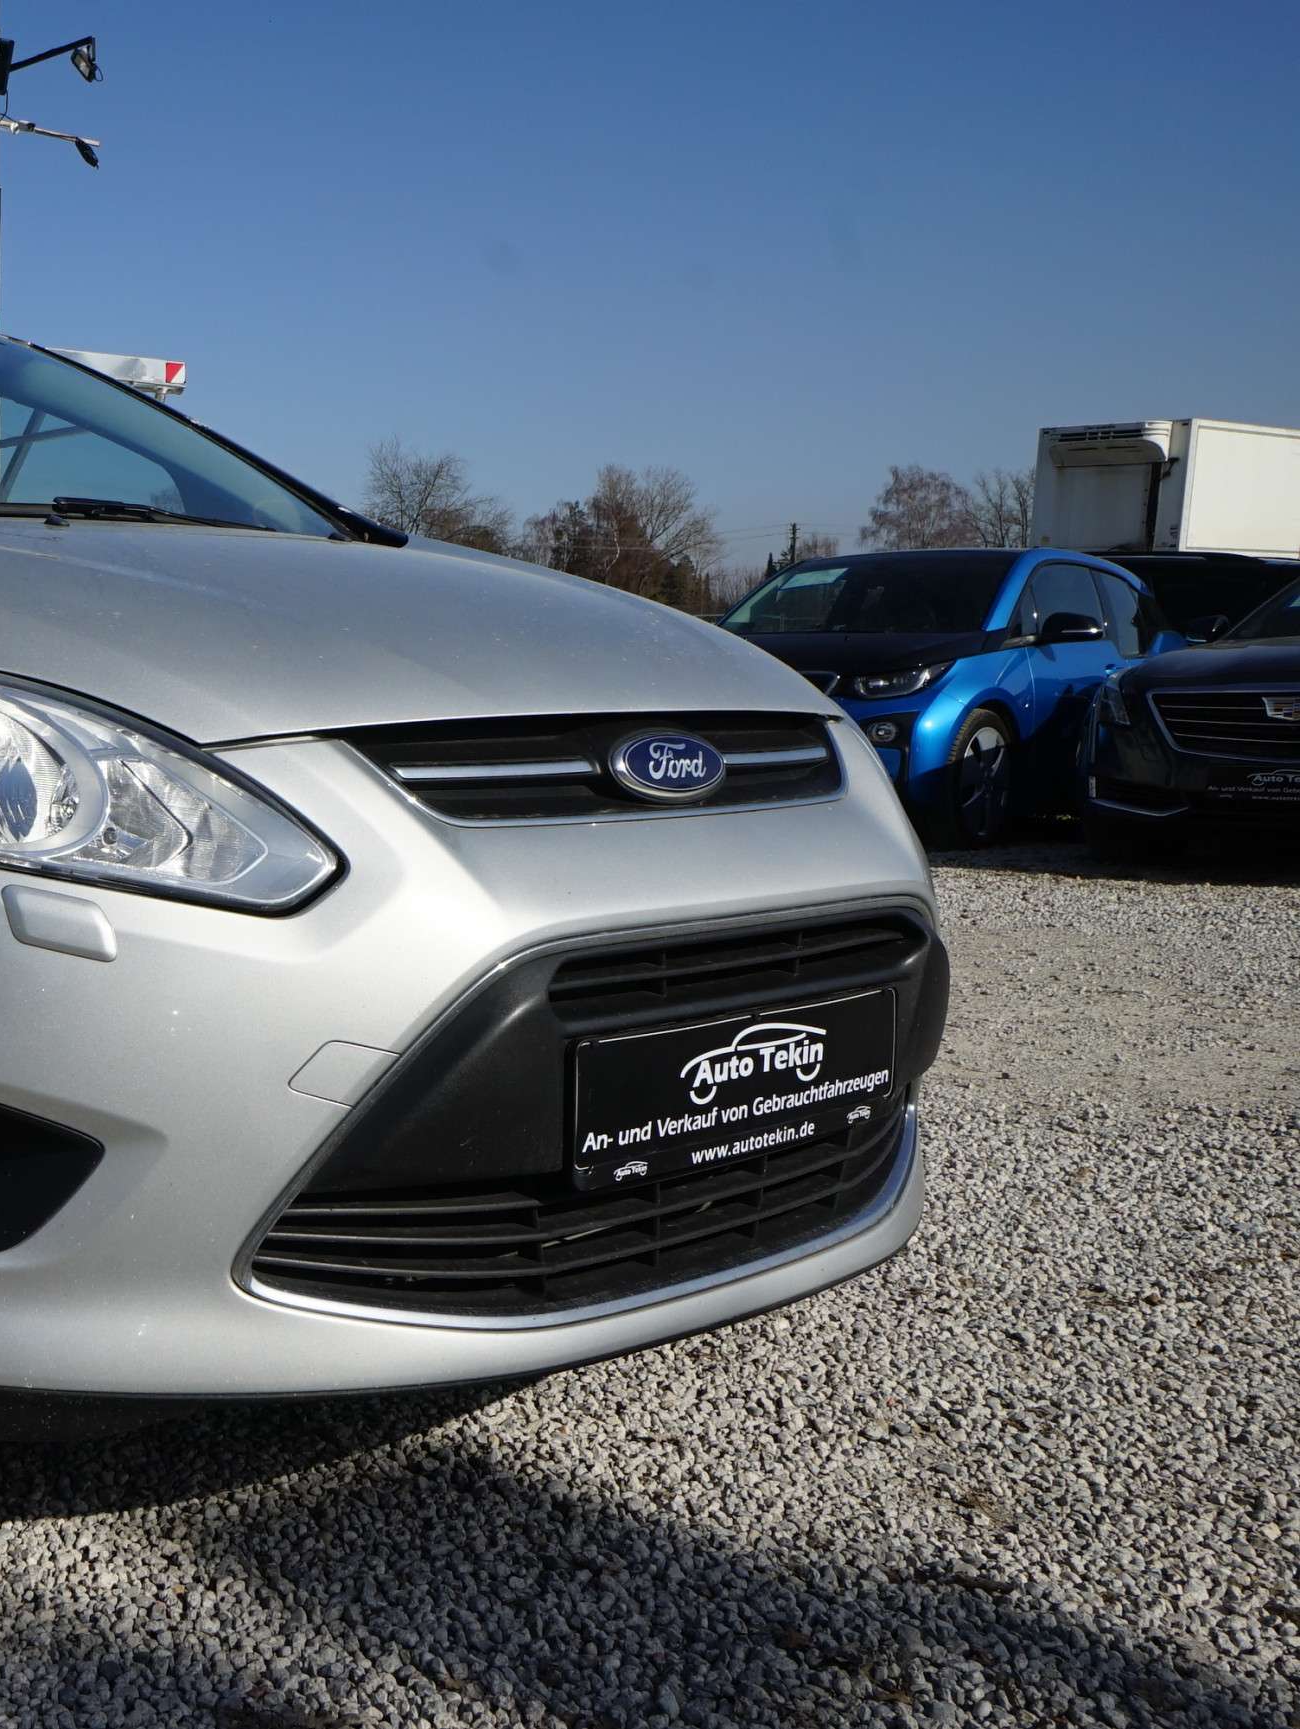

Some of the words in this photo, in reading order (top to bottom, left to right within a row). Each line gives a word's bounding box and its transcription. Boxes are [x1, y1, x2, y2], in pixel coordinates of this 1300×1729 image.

[648, 742, 707, 780] Ford
[692, 1055, 754, 1088] Auto
[759, 1040, 824, 1073] Tekin
[582, 1132, 614, 1153] An-
[618, 1121, 652, 1147] und
[657, 1107, 718, 1138] Verkauf
[721, 1104, 748, 1124] von
[753, 1069, 889, 1116] Gebrauchtfahrzeugen
[691, 1121, 815, 1164] www.autotekin.de
